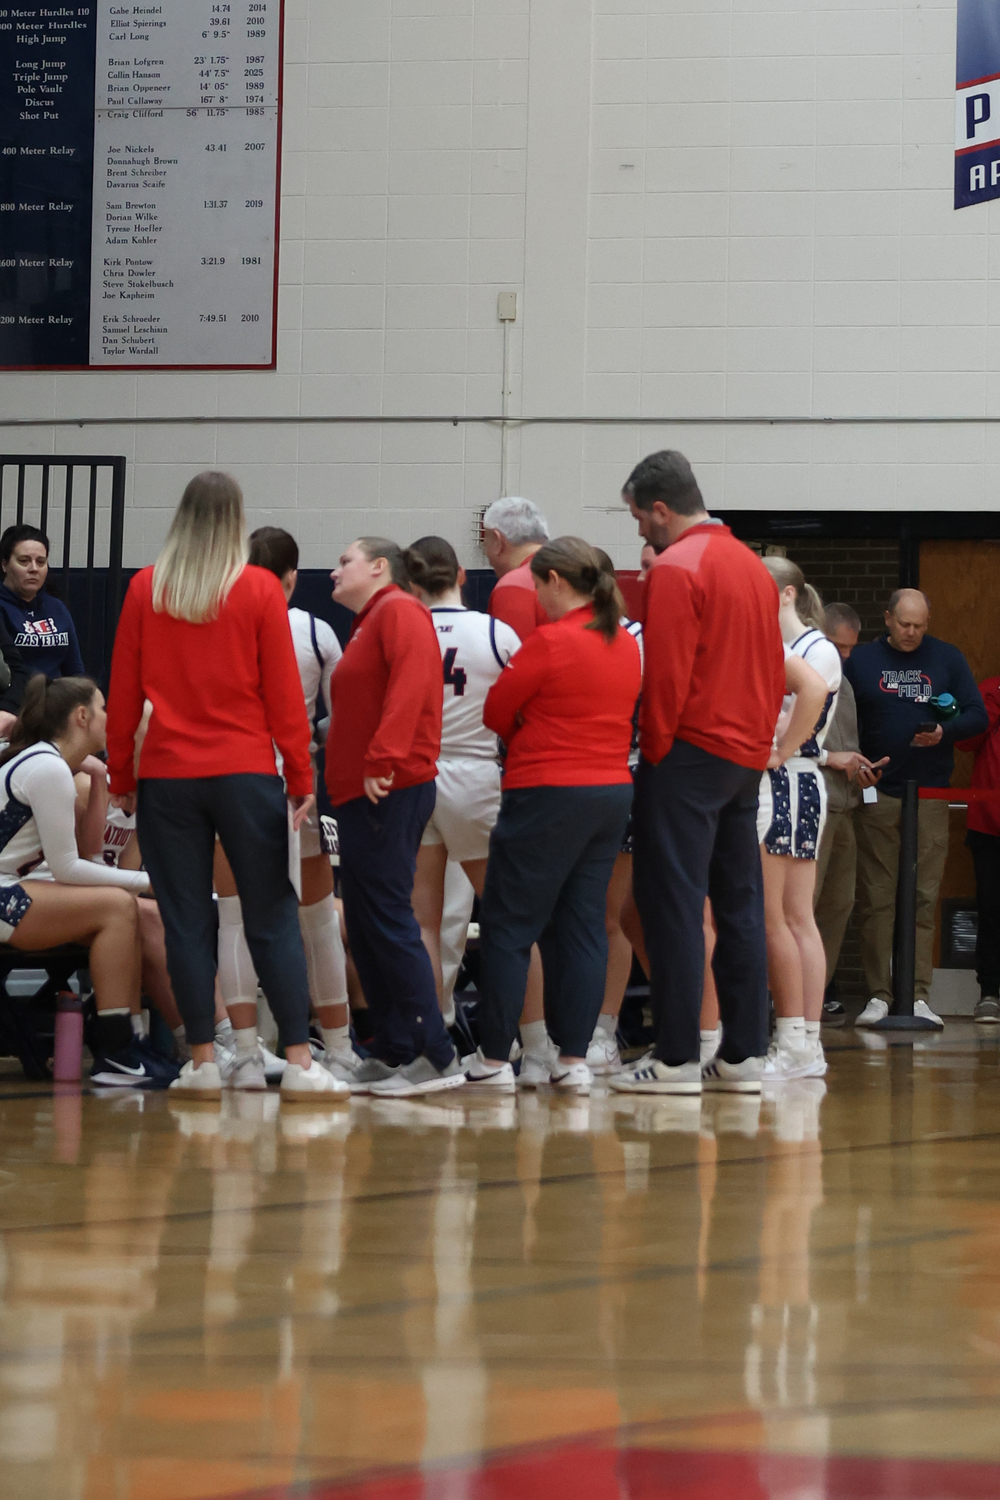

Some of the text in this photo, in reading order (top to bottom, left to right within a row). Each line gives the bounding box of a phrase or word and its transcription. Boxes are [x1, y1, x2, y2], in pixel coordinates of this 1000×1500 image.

[16, 34, 67, 45] High Jump
[109, 30, 266, 41] Carl Long 1989
[17, 84, 63, 93] Pole Vault
[19, 111, 59, 120] Shot Put
[107, 107, 265, 119] Craig Clifford 1985
[20, 146, 46, 155] Meter
[50, 145, 75, 156] Relay
[107, 145, 122, 154] Joe
[244, 143, 266, 151] 2007
[105, 236, 158, 244] Adam Kohler
[241, 257, 261, 265] 1981
[102, 336, 155, 345] Dan Schubert
[882, 669, 922, 683] TRACK
[898, 684, 932, 698] FIELD
